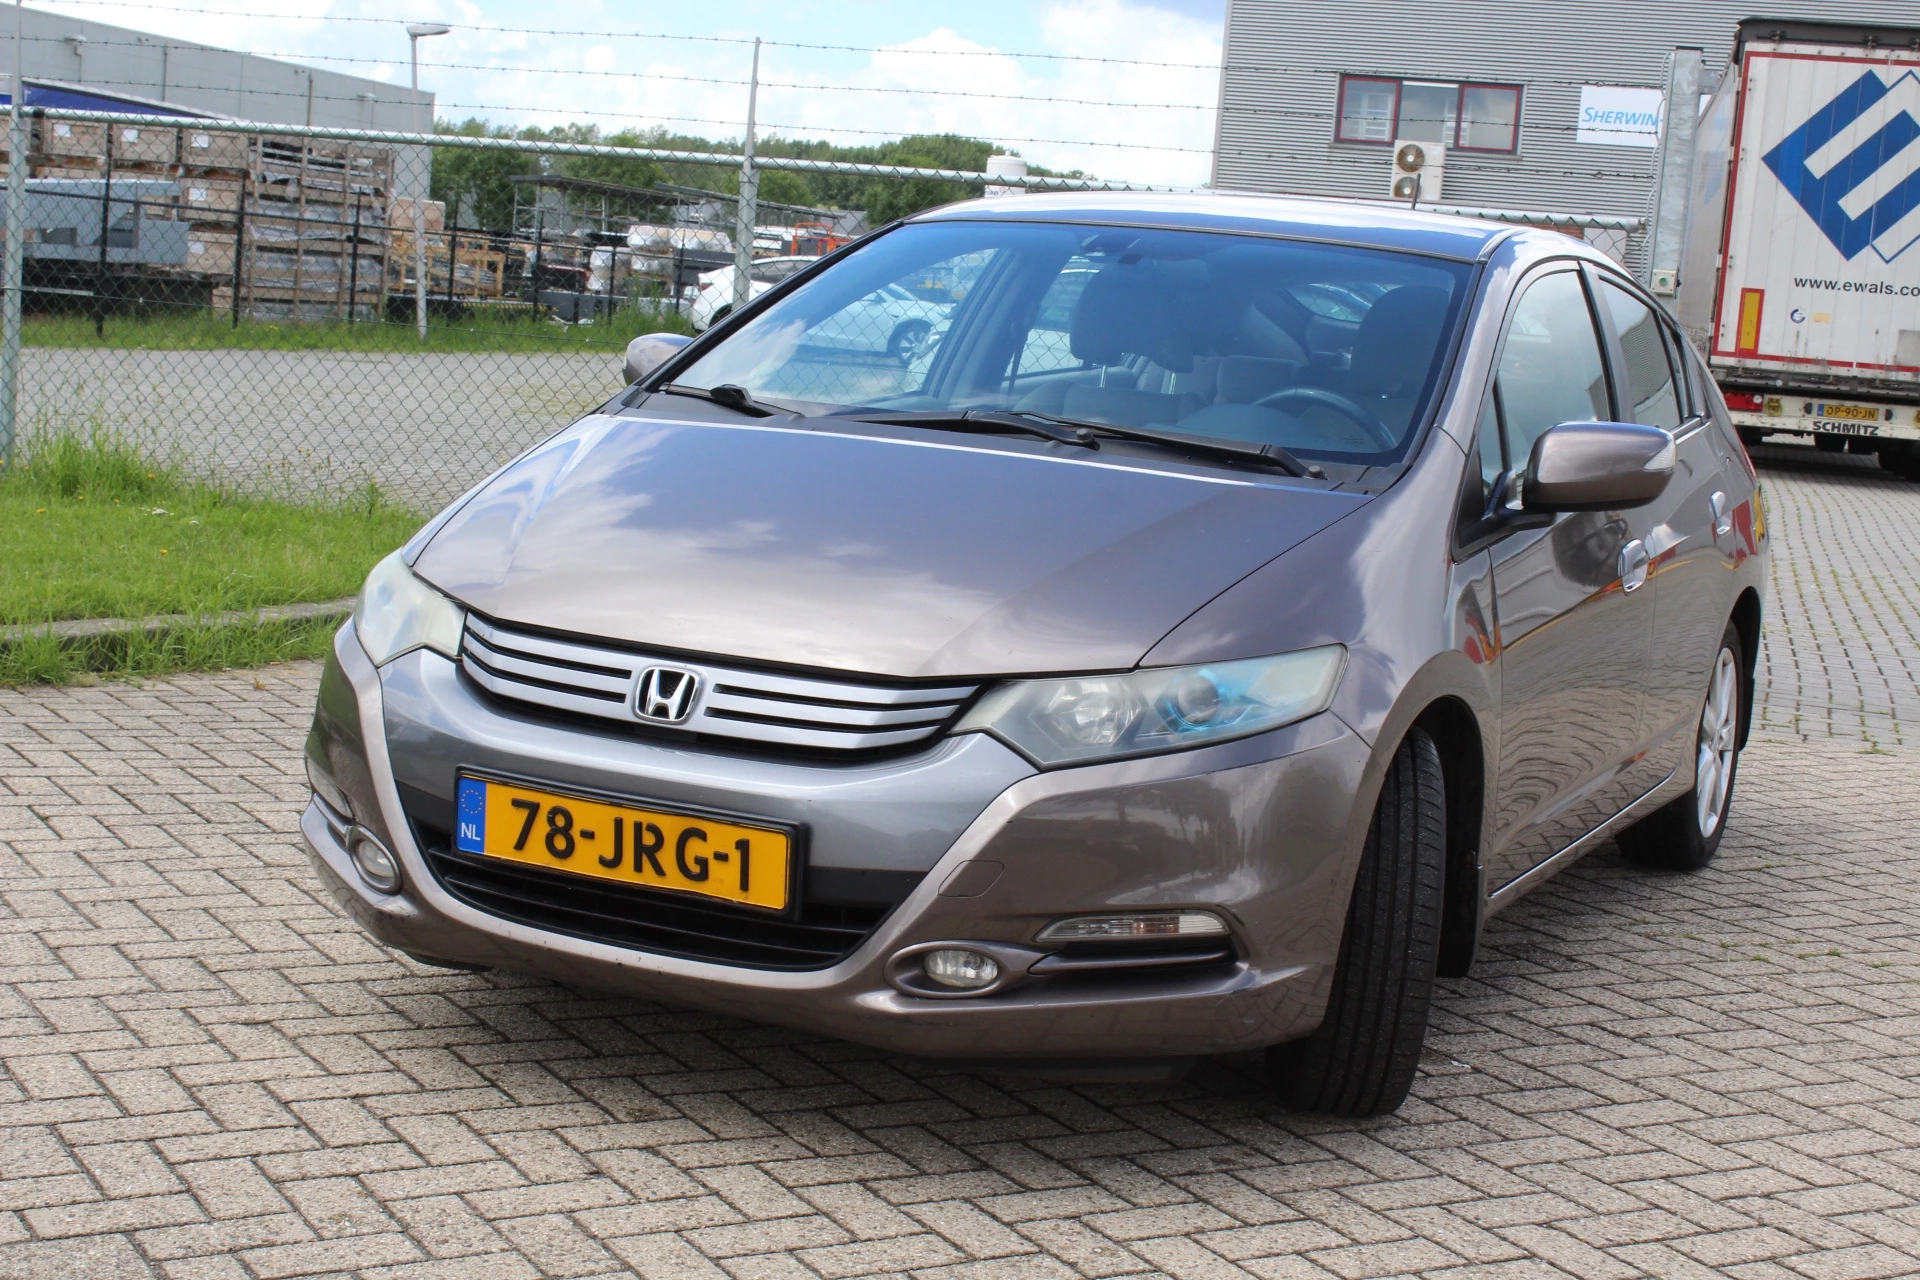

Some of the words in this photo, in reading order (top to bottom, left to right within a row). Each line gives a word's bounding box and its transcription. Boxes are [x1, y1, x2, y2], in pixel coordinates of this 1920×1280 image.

[1826, 406, 1876, 419] OP-90-JN
[1812, 421, 1879, 436] SCHMITZ
[461, 822, 481, 840] NL
[511, 798, 750, 891] 78-JRG-1
